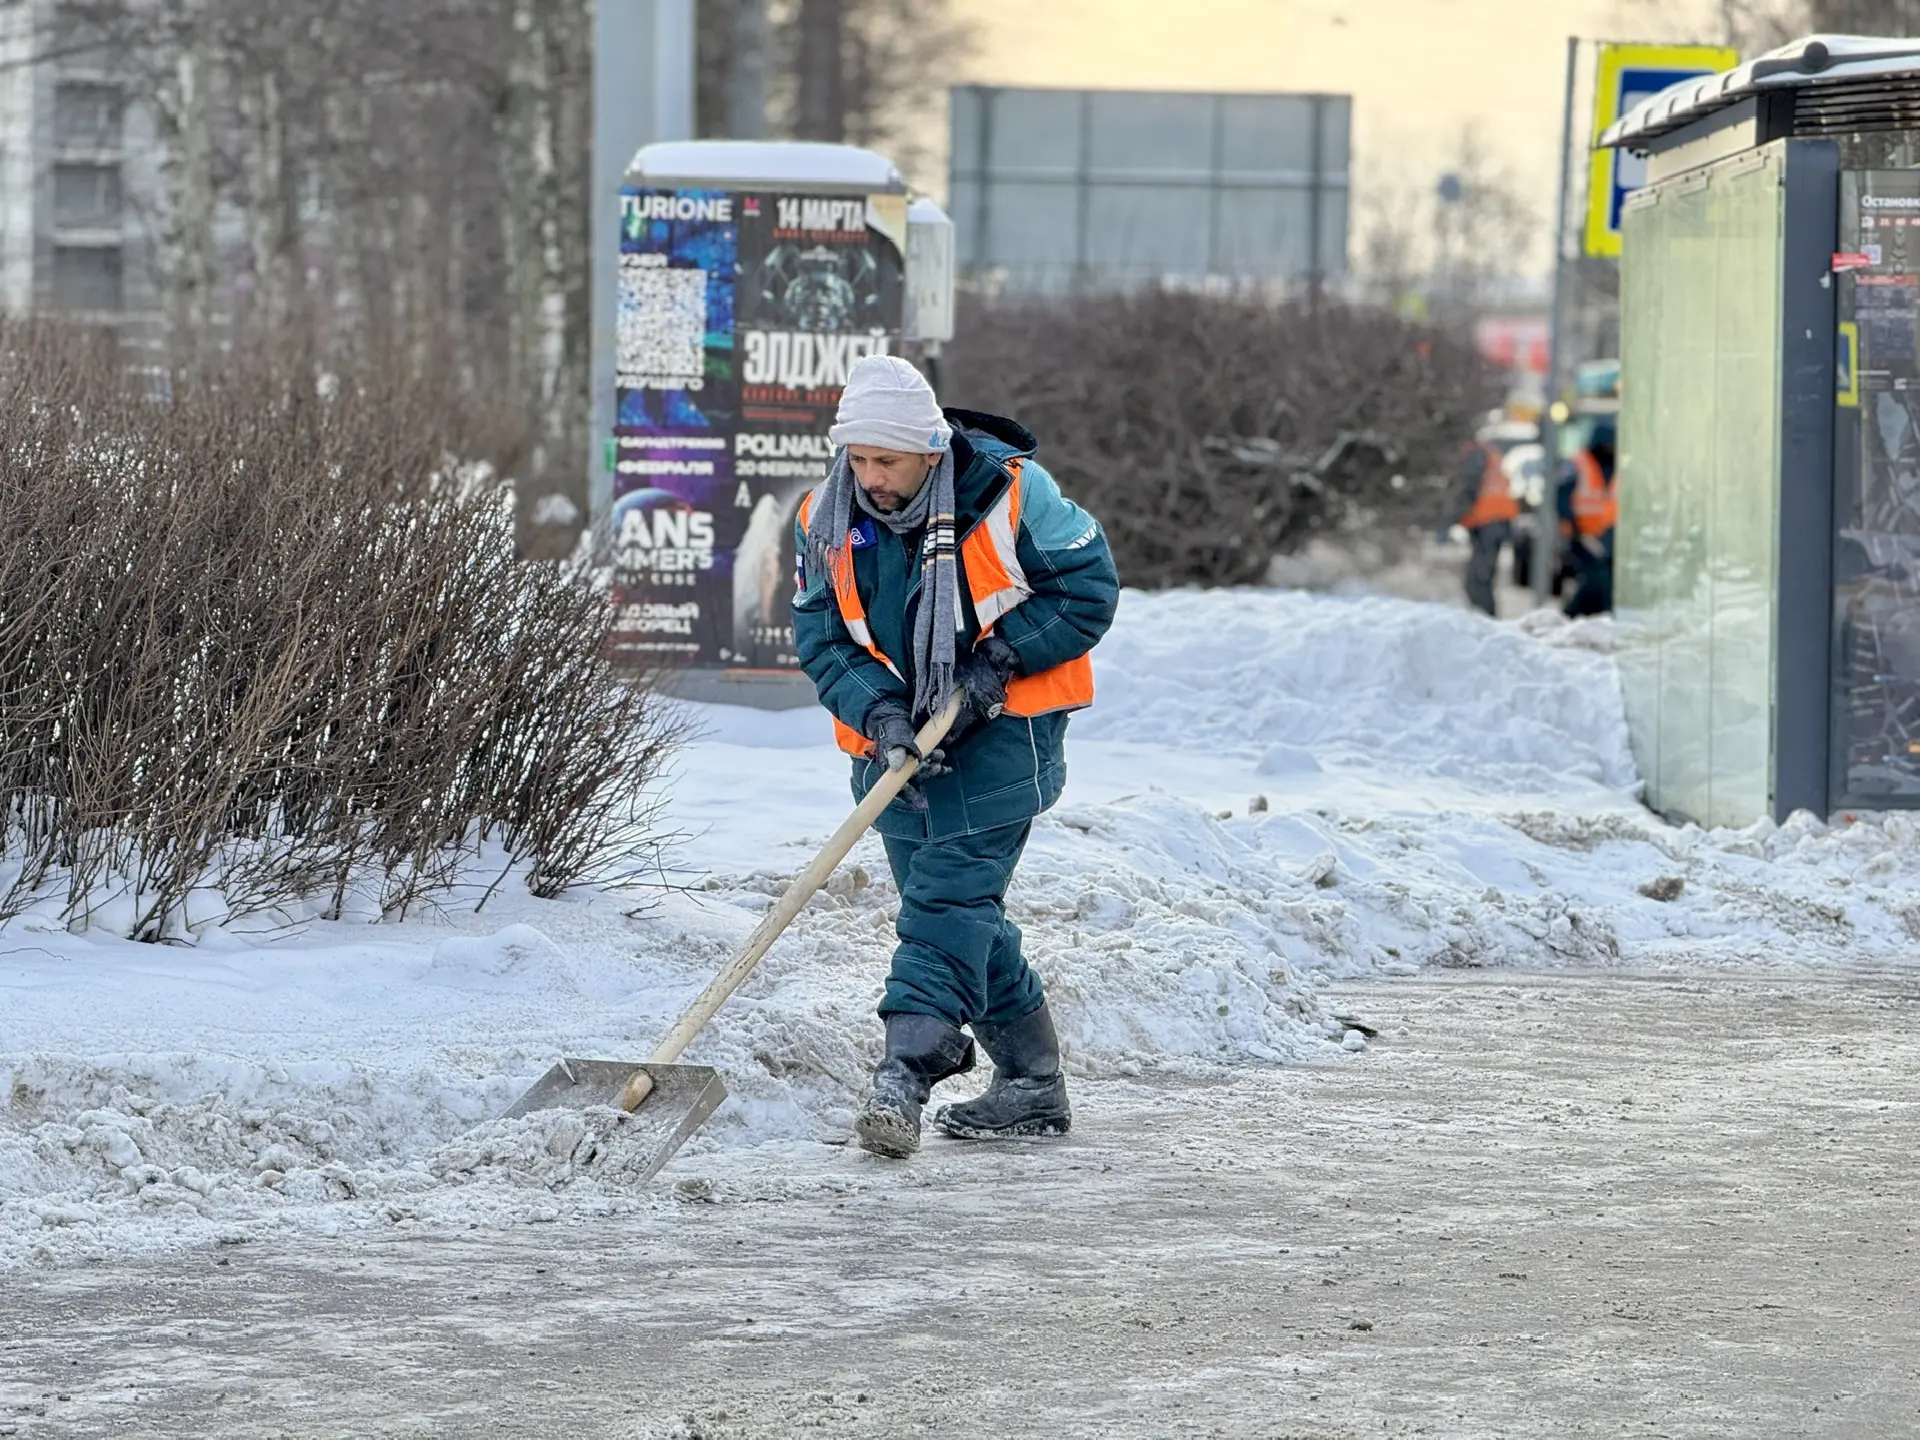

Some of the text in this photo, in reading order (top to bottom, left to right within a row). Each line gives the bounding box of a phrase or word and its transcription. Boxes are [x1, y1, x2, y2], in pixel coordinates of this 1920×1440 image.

[618, 195, 732, 221] TURIONE
[777, 197, 865, 231] 14 МАРТА
[618, 460, 714, 475] ФЕВРАЛЯ
[618, 509, 714, 548] ANS
